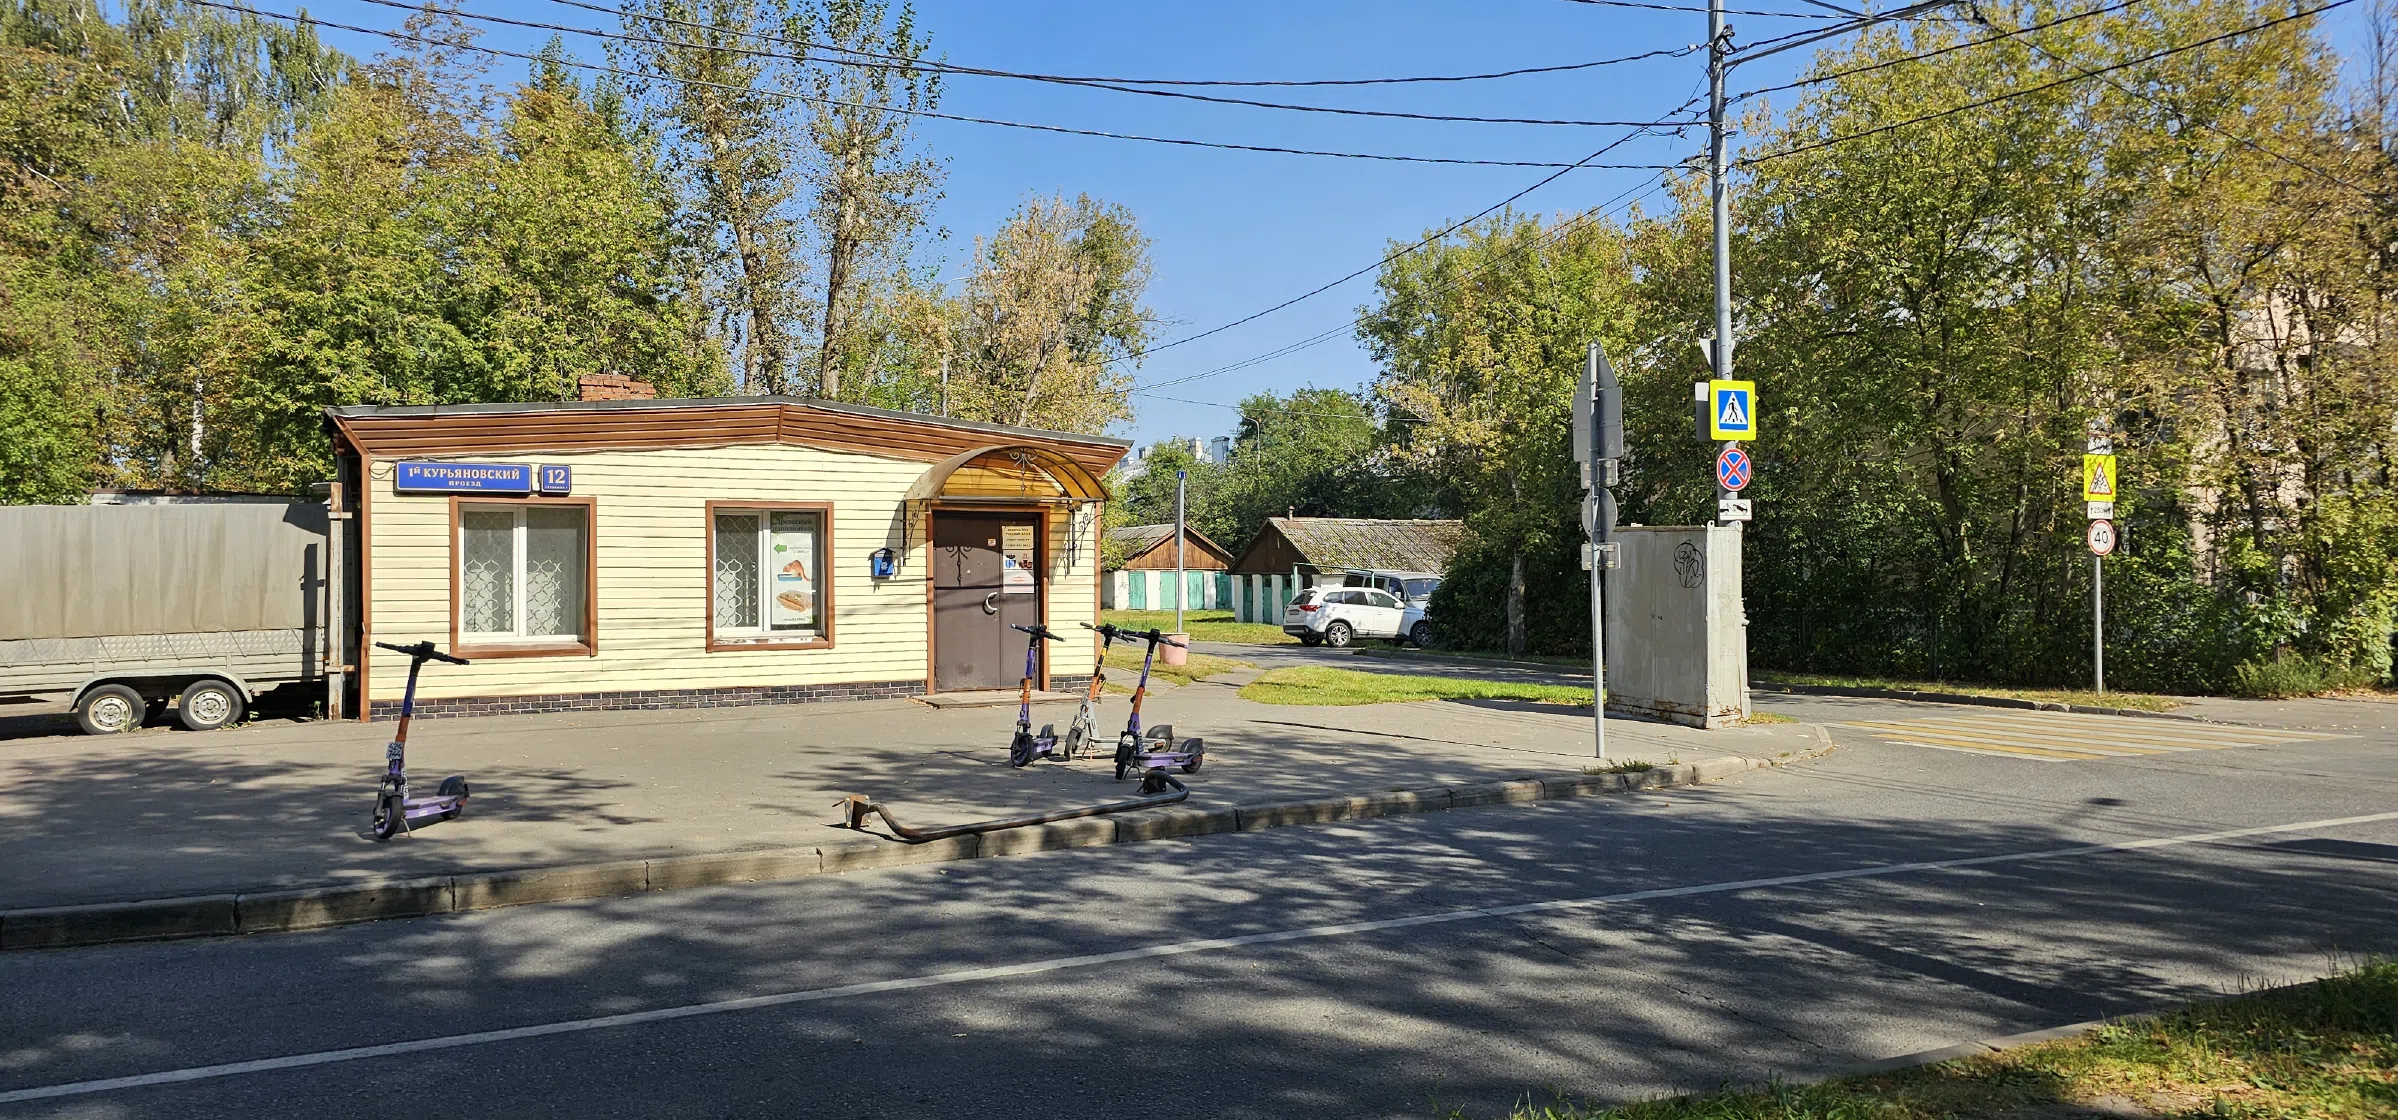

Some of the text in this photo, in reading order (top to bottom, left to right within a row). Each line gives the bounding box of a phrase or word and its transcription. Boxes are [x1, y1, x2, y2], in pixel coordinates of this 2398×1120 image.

[423, 467, 520, 480] КУРЬЯНОВСКИЙ
[547, 469, 566, 484] 12
[2094, 531, 2108, 544] 40
